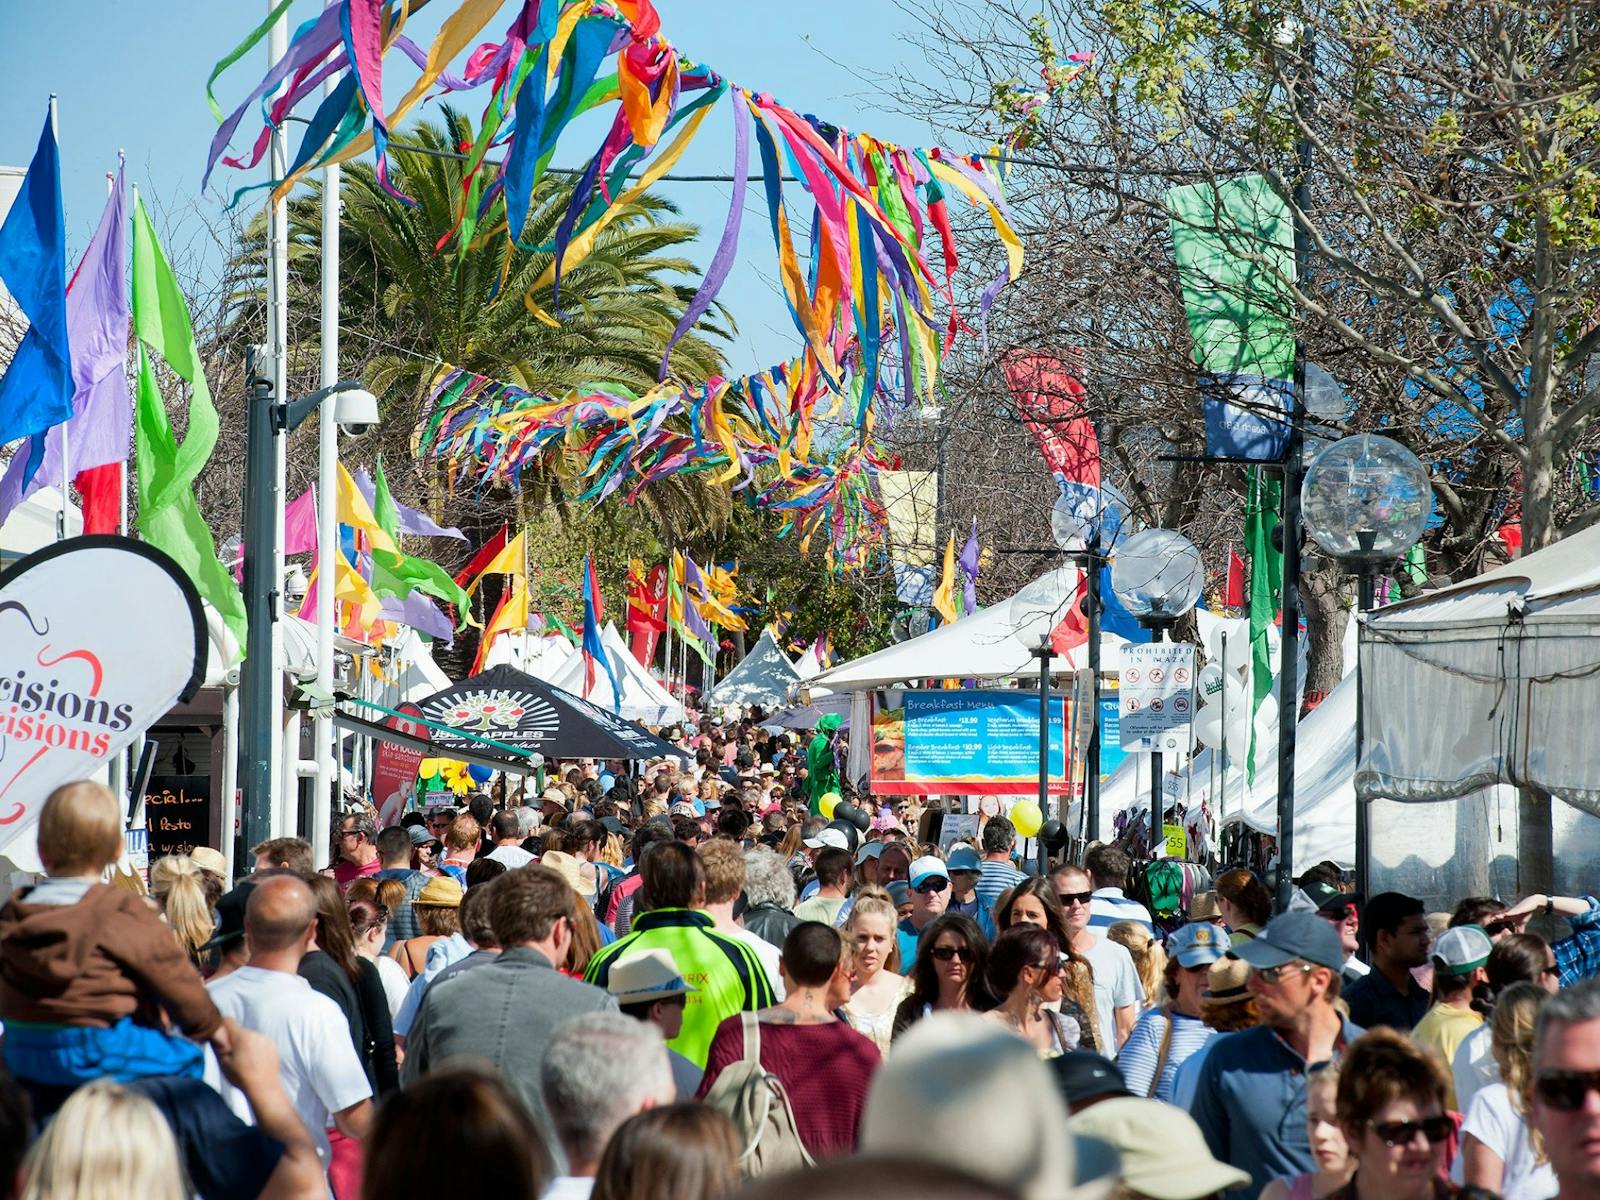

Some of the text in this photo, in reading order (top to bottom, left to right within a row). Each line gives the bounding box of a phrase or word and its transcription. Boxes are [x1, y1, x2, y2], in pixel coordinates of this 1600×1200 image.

[1123, 647, 1192, 655] PROHIBITED
[907, 699, 995, 710] Breakfast Menu
[480, 731, 544, 739] APPLES
